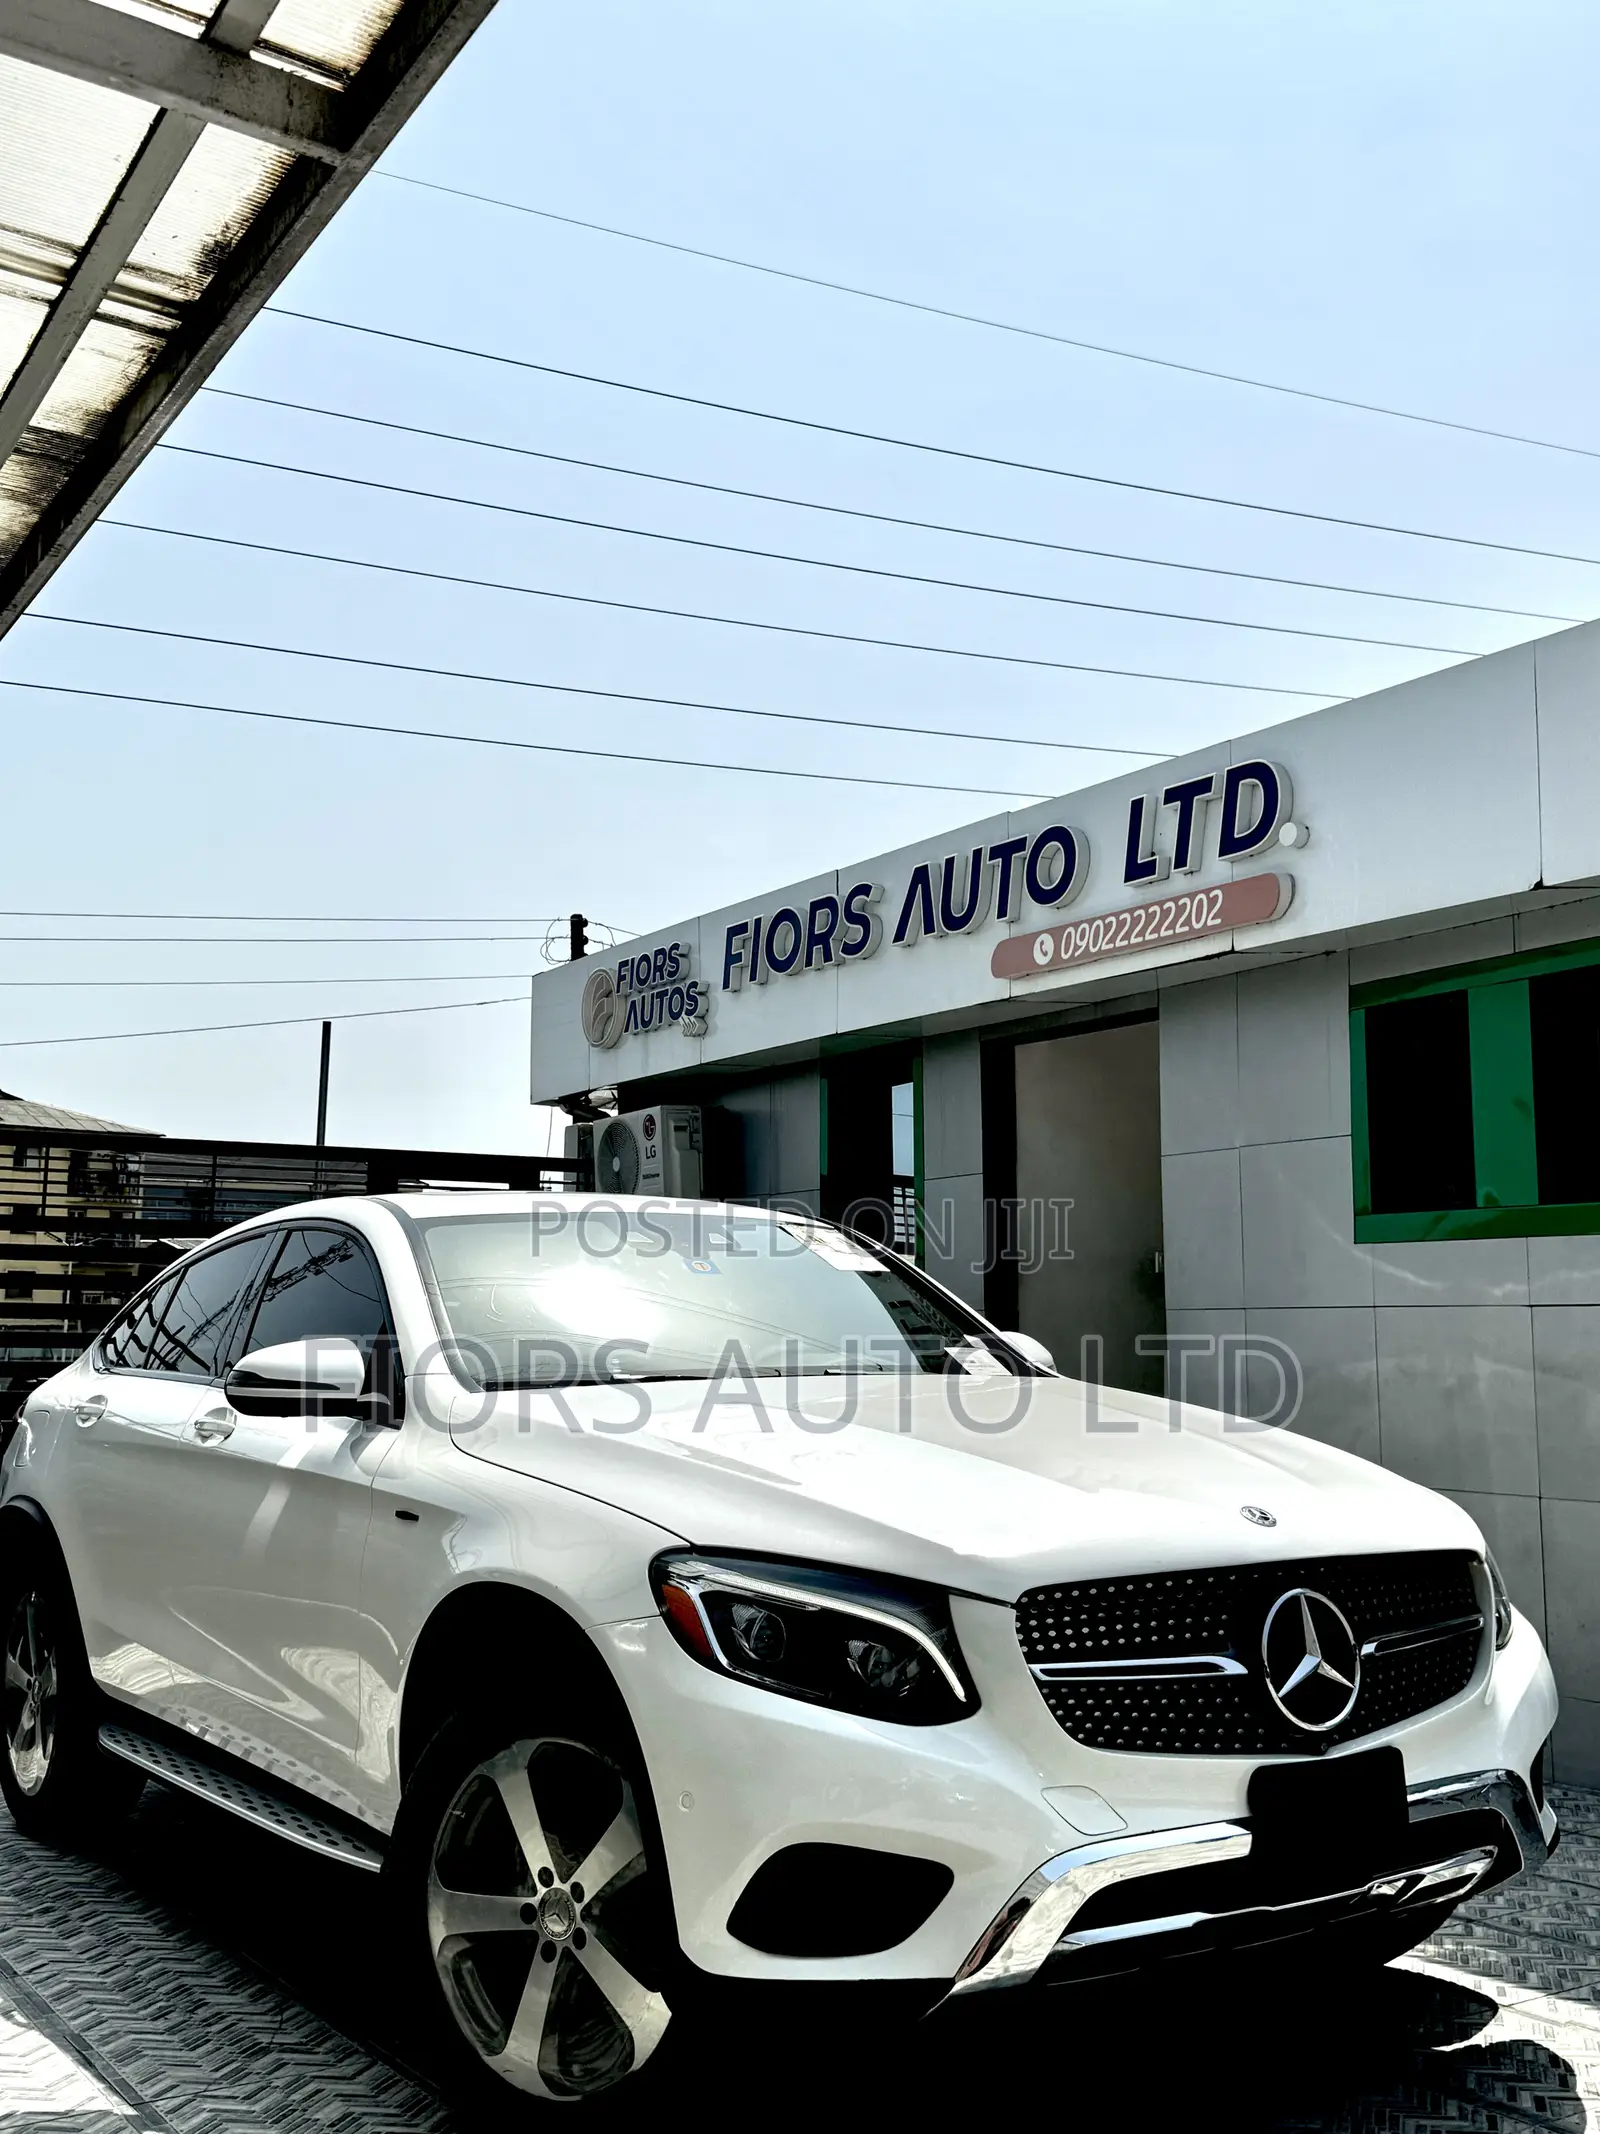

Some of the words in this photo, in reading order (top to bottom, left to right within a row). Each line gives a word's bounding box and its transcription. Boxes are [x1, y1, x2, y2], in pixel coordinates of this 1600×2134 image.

[722, 881, 884, 992] FIORS
[891, 823, 1082, 947] AUTO
[1123, 758, 1302, 887] LTD.
[1060, 888, 1225, 961] 09022222202
[616, 940, 684, 996] FIORS
[623, 979, 701, 1035] AUTOS
[645, 1144, 657, 1160] LG
